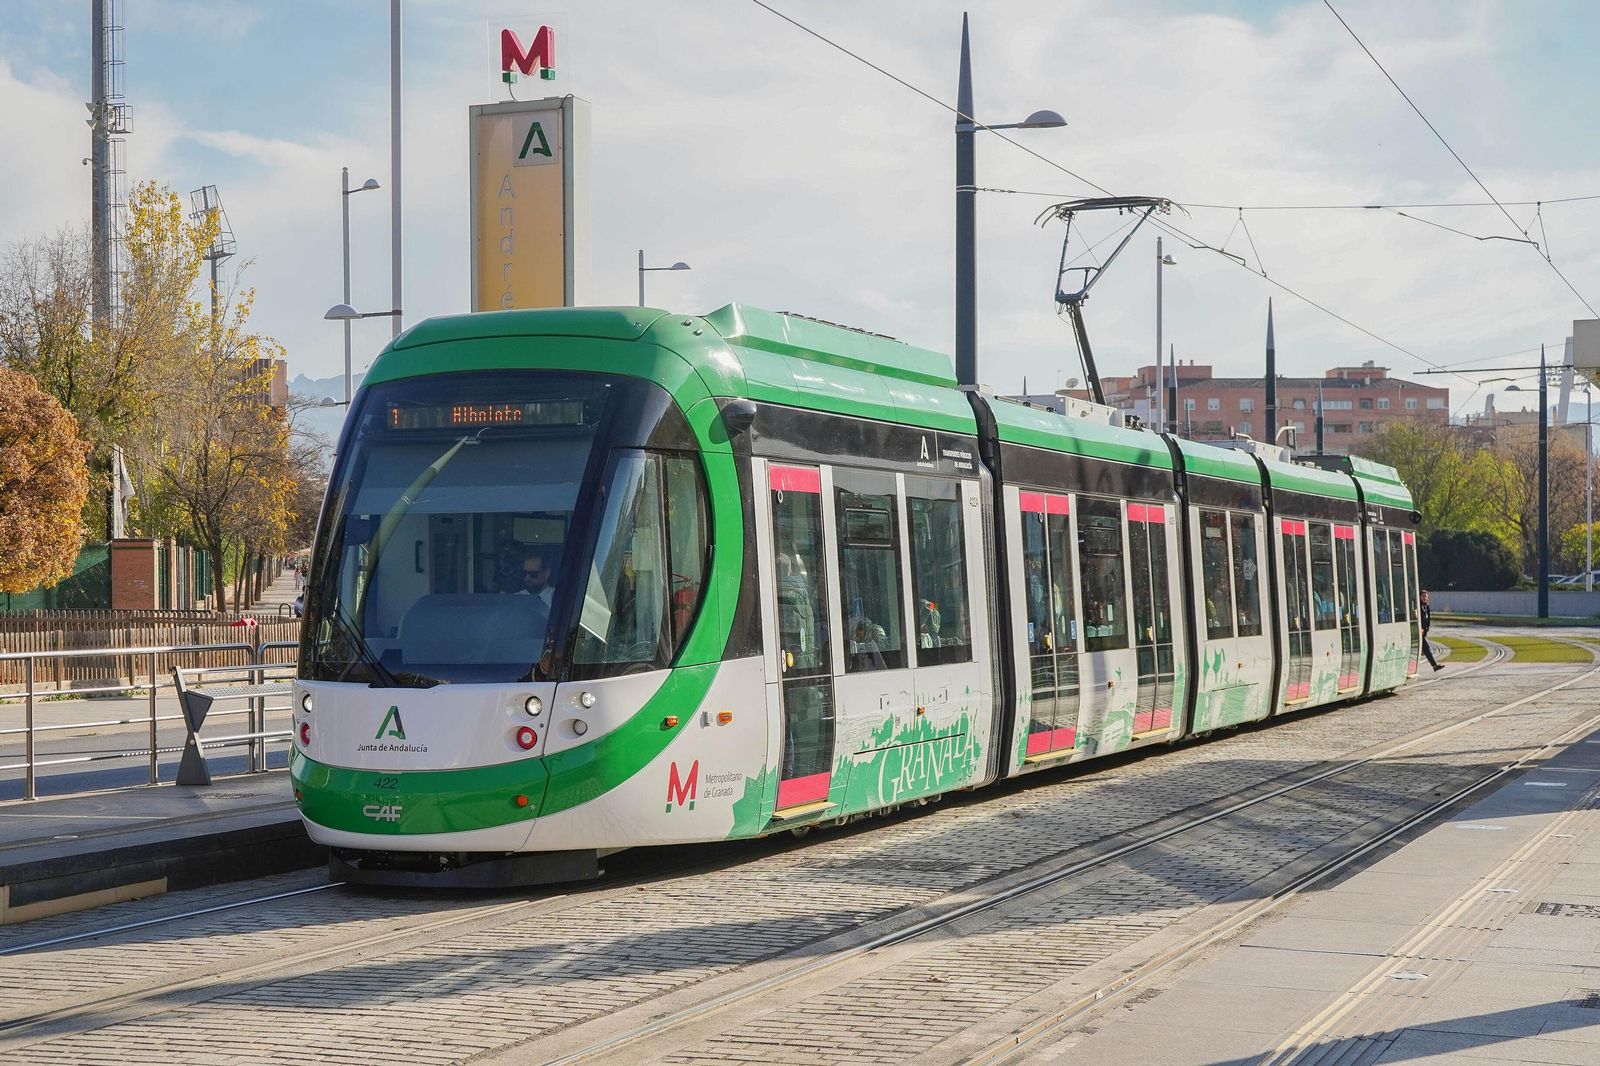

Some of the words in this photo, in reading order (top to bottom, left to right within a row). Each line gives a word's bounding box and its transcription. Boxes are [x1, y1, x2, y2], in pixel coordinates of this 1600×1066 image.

[501, 25, 555, 83] M
[518, 121, 553, 159] A
[375, 705, 406, 740] A
[357, 743, 377, 752] Junta
[378, 743, 388, 752] de
[389, 743, 428, 753] Andalucía
[374, 778, 399, 789] 422
[665, 759, 699, 813] M
[705, 771, 742, 784] Metropolitano
[704, 788, 711, 799] de
[712, 786, 734, 798] Granada
[362, 804, 403, 822] CAF
